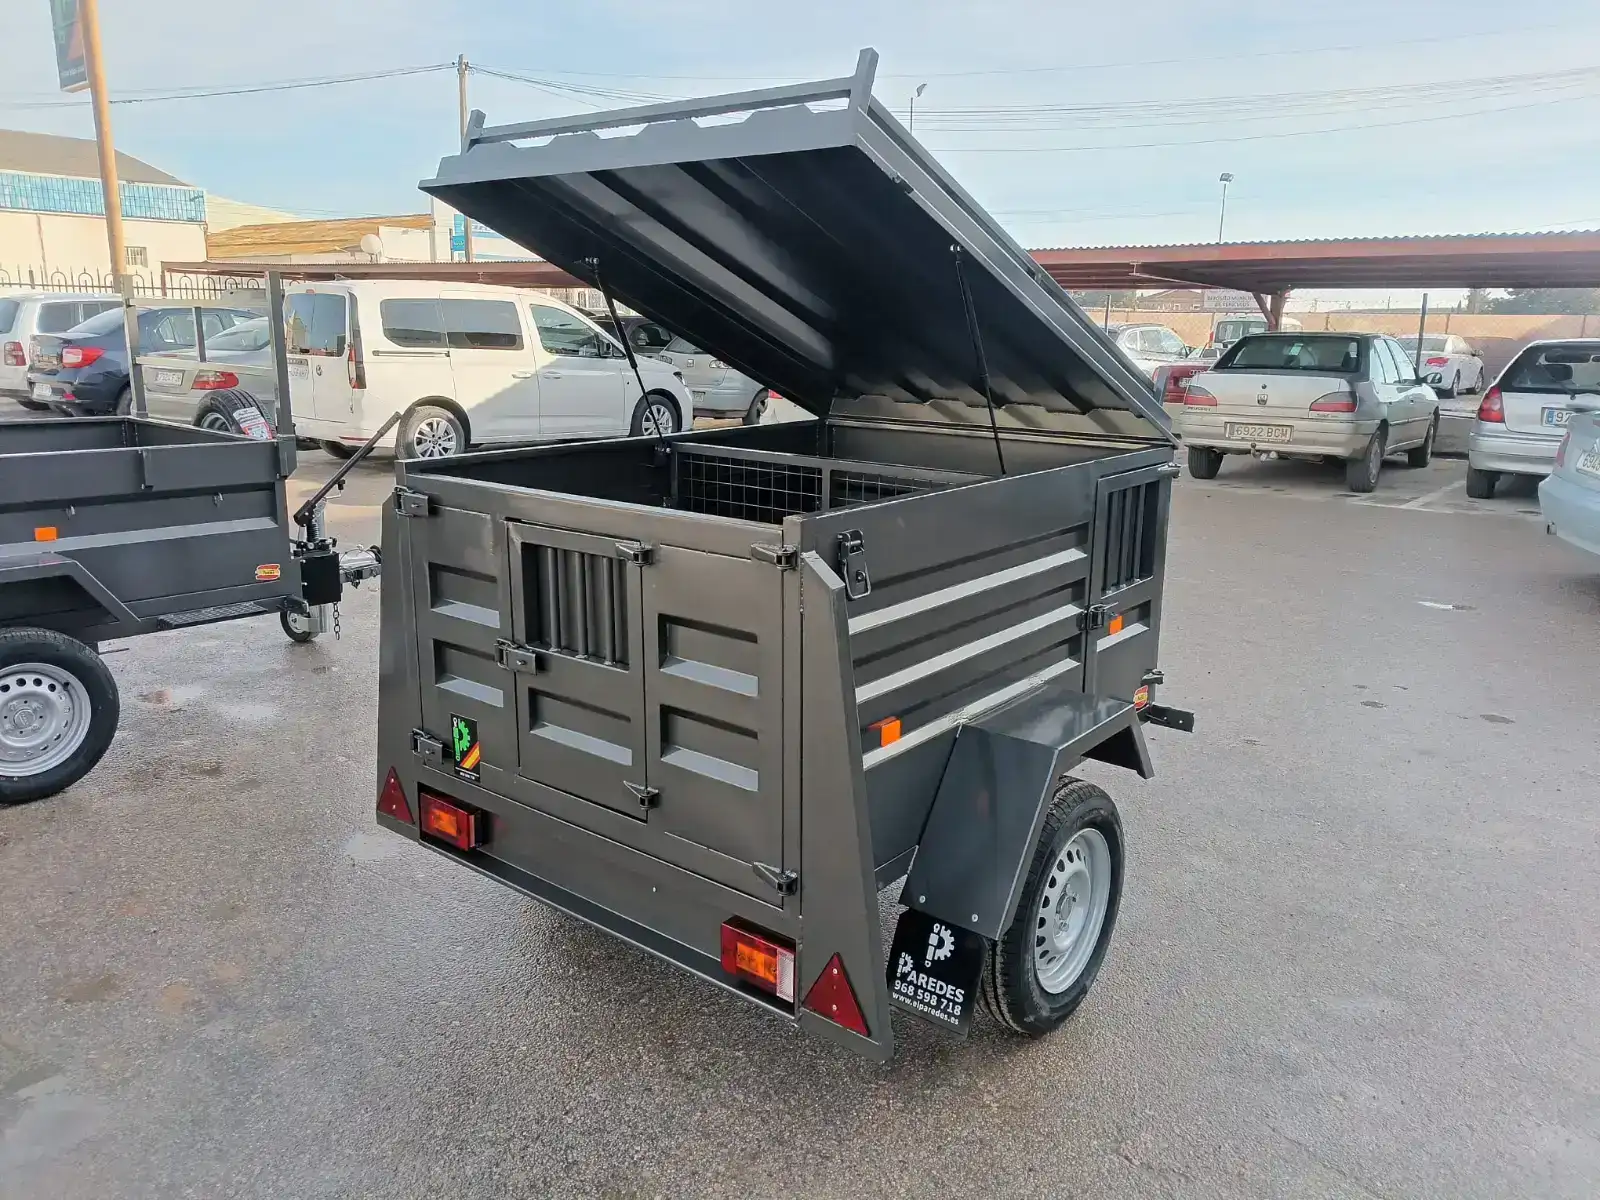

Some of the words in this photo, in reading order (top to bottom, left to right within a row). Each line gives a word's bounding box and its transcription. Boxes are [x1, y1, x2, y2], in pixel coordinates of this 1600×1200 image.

[1235, 426, 1264, 437] 6922
[892, 991, 959, 1025] www.elparedes.es
[894, 980, 914, 996] 968
[917, 990, 938, 1006] 598
[940, 998, 962, 1016] 718
